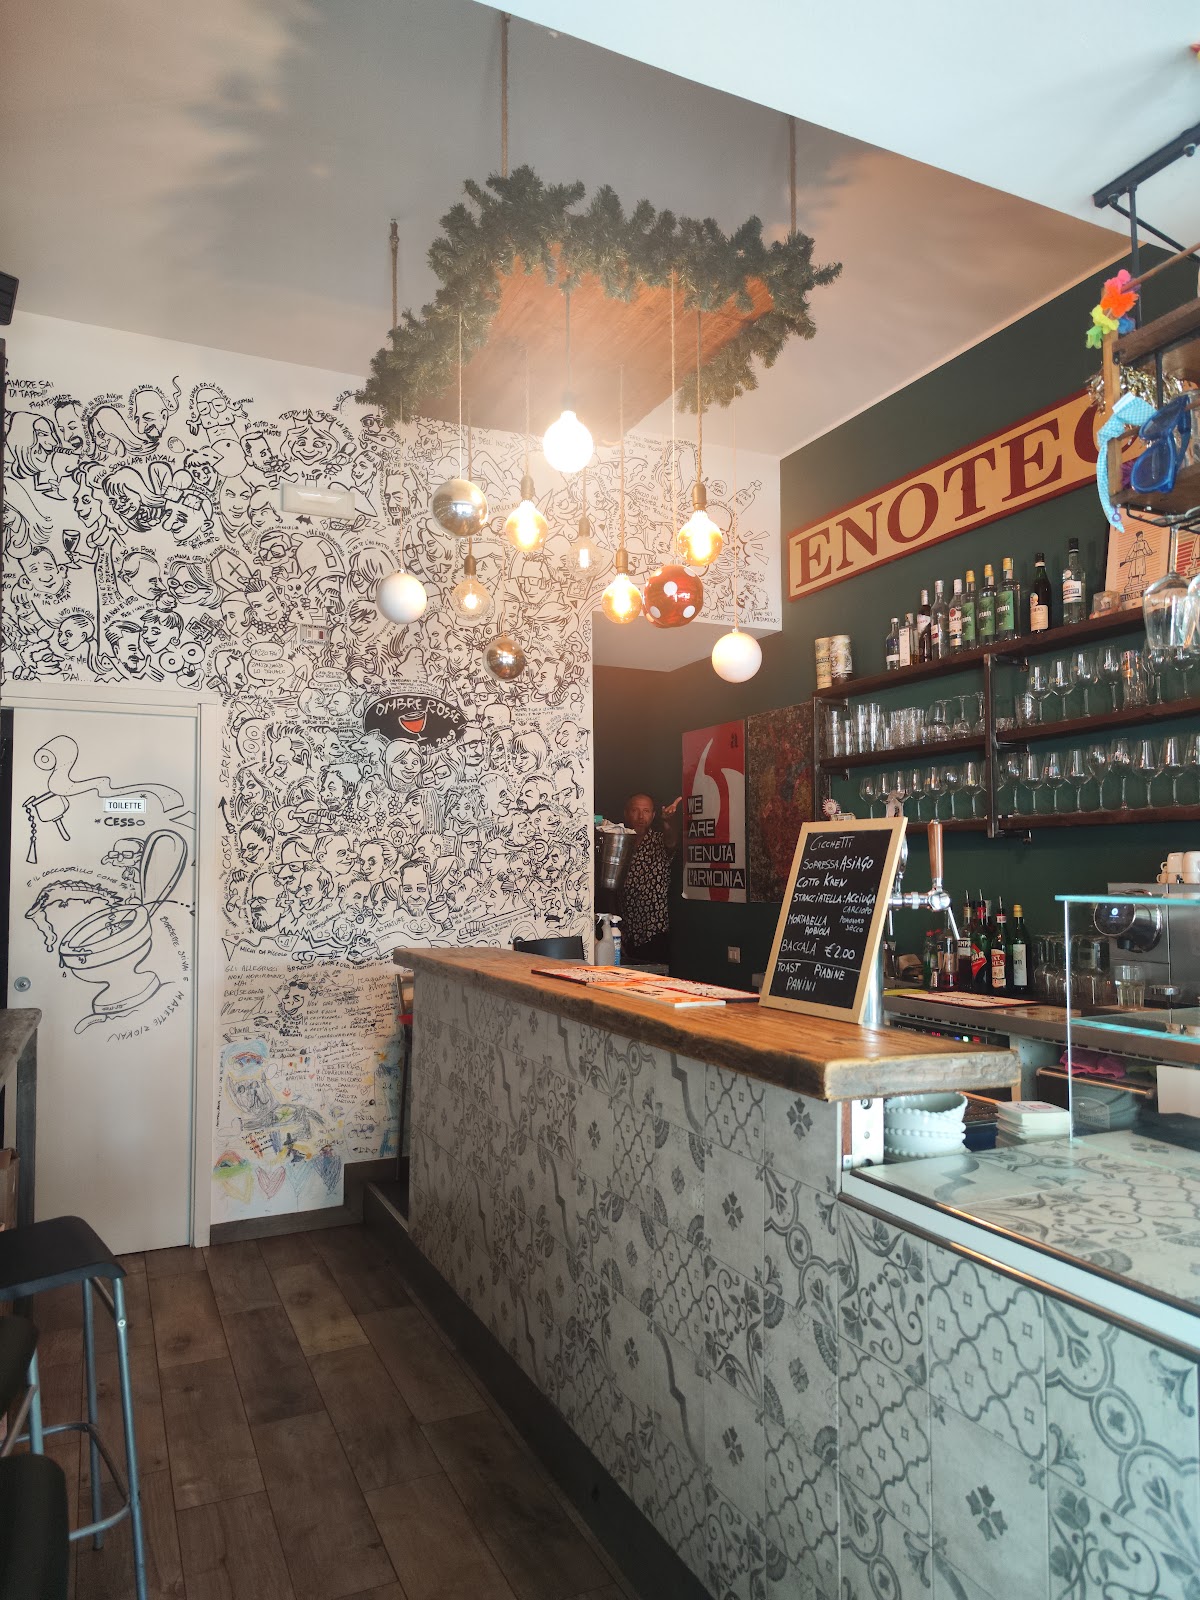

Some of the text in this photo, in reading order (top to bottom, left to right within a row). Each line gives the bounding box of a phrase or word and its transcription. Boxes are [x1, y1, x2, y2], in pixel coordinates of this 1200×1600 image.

[5, 379, 37, 389] AMORE
[278, 410, 300, 421] TEDDY
[302, 408, 313, 417] HA
[316, 410, 338, 422] PERSO
[796, 398, 1132, 589] ENOTEC
[64, 652, 75, 661] SE
[64, 664, 73, 672] LA
[375, 698, 462, 724] OMBRE ROSSE
[108, 802, 142, 810] TOILETTE
[688, 797, 703, 813] WE
[104, 817, 146, 828] CESSO
[688, 820, 715, 838] ARE
[810, 836, 855, 850] CICCHETTI
[688, 846, 734, 862] TENUTA
[803, 856, 874, 870] SOPRESSA ASIAGO
[97, 873, 118, 884] COME
[688, 870, 744, 887] L'ARMONIA
[796, 872, 848, 888] COTTO KREN
[846, 892, 876, 904] ACCIUGA
[788, 914, 828, 926] MORTADELLA
[804, 926, 830, 936] ROBIOLA
[824, 943, 856, 960] €2.00
[777, 962, 846, 981] TOAST PIADINE
[786, 976, 817, 992] PANINI
